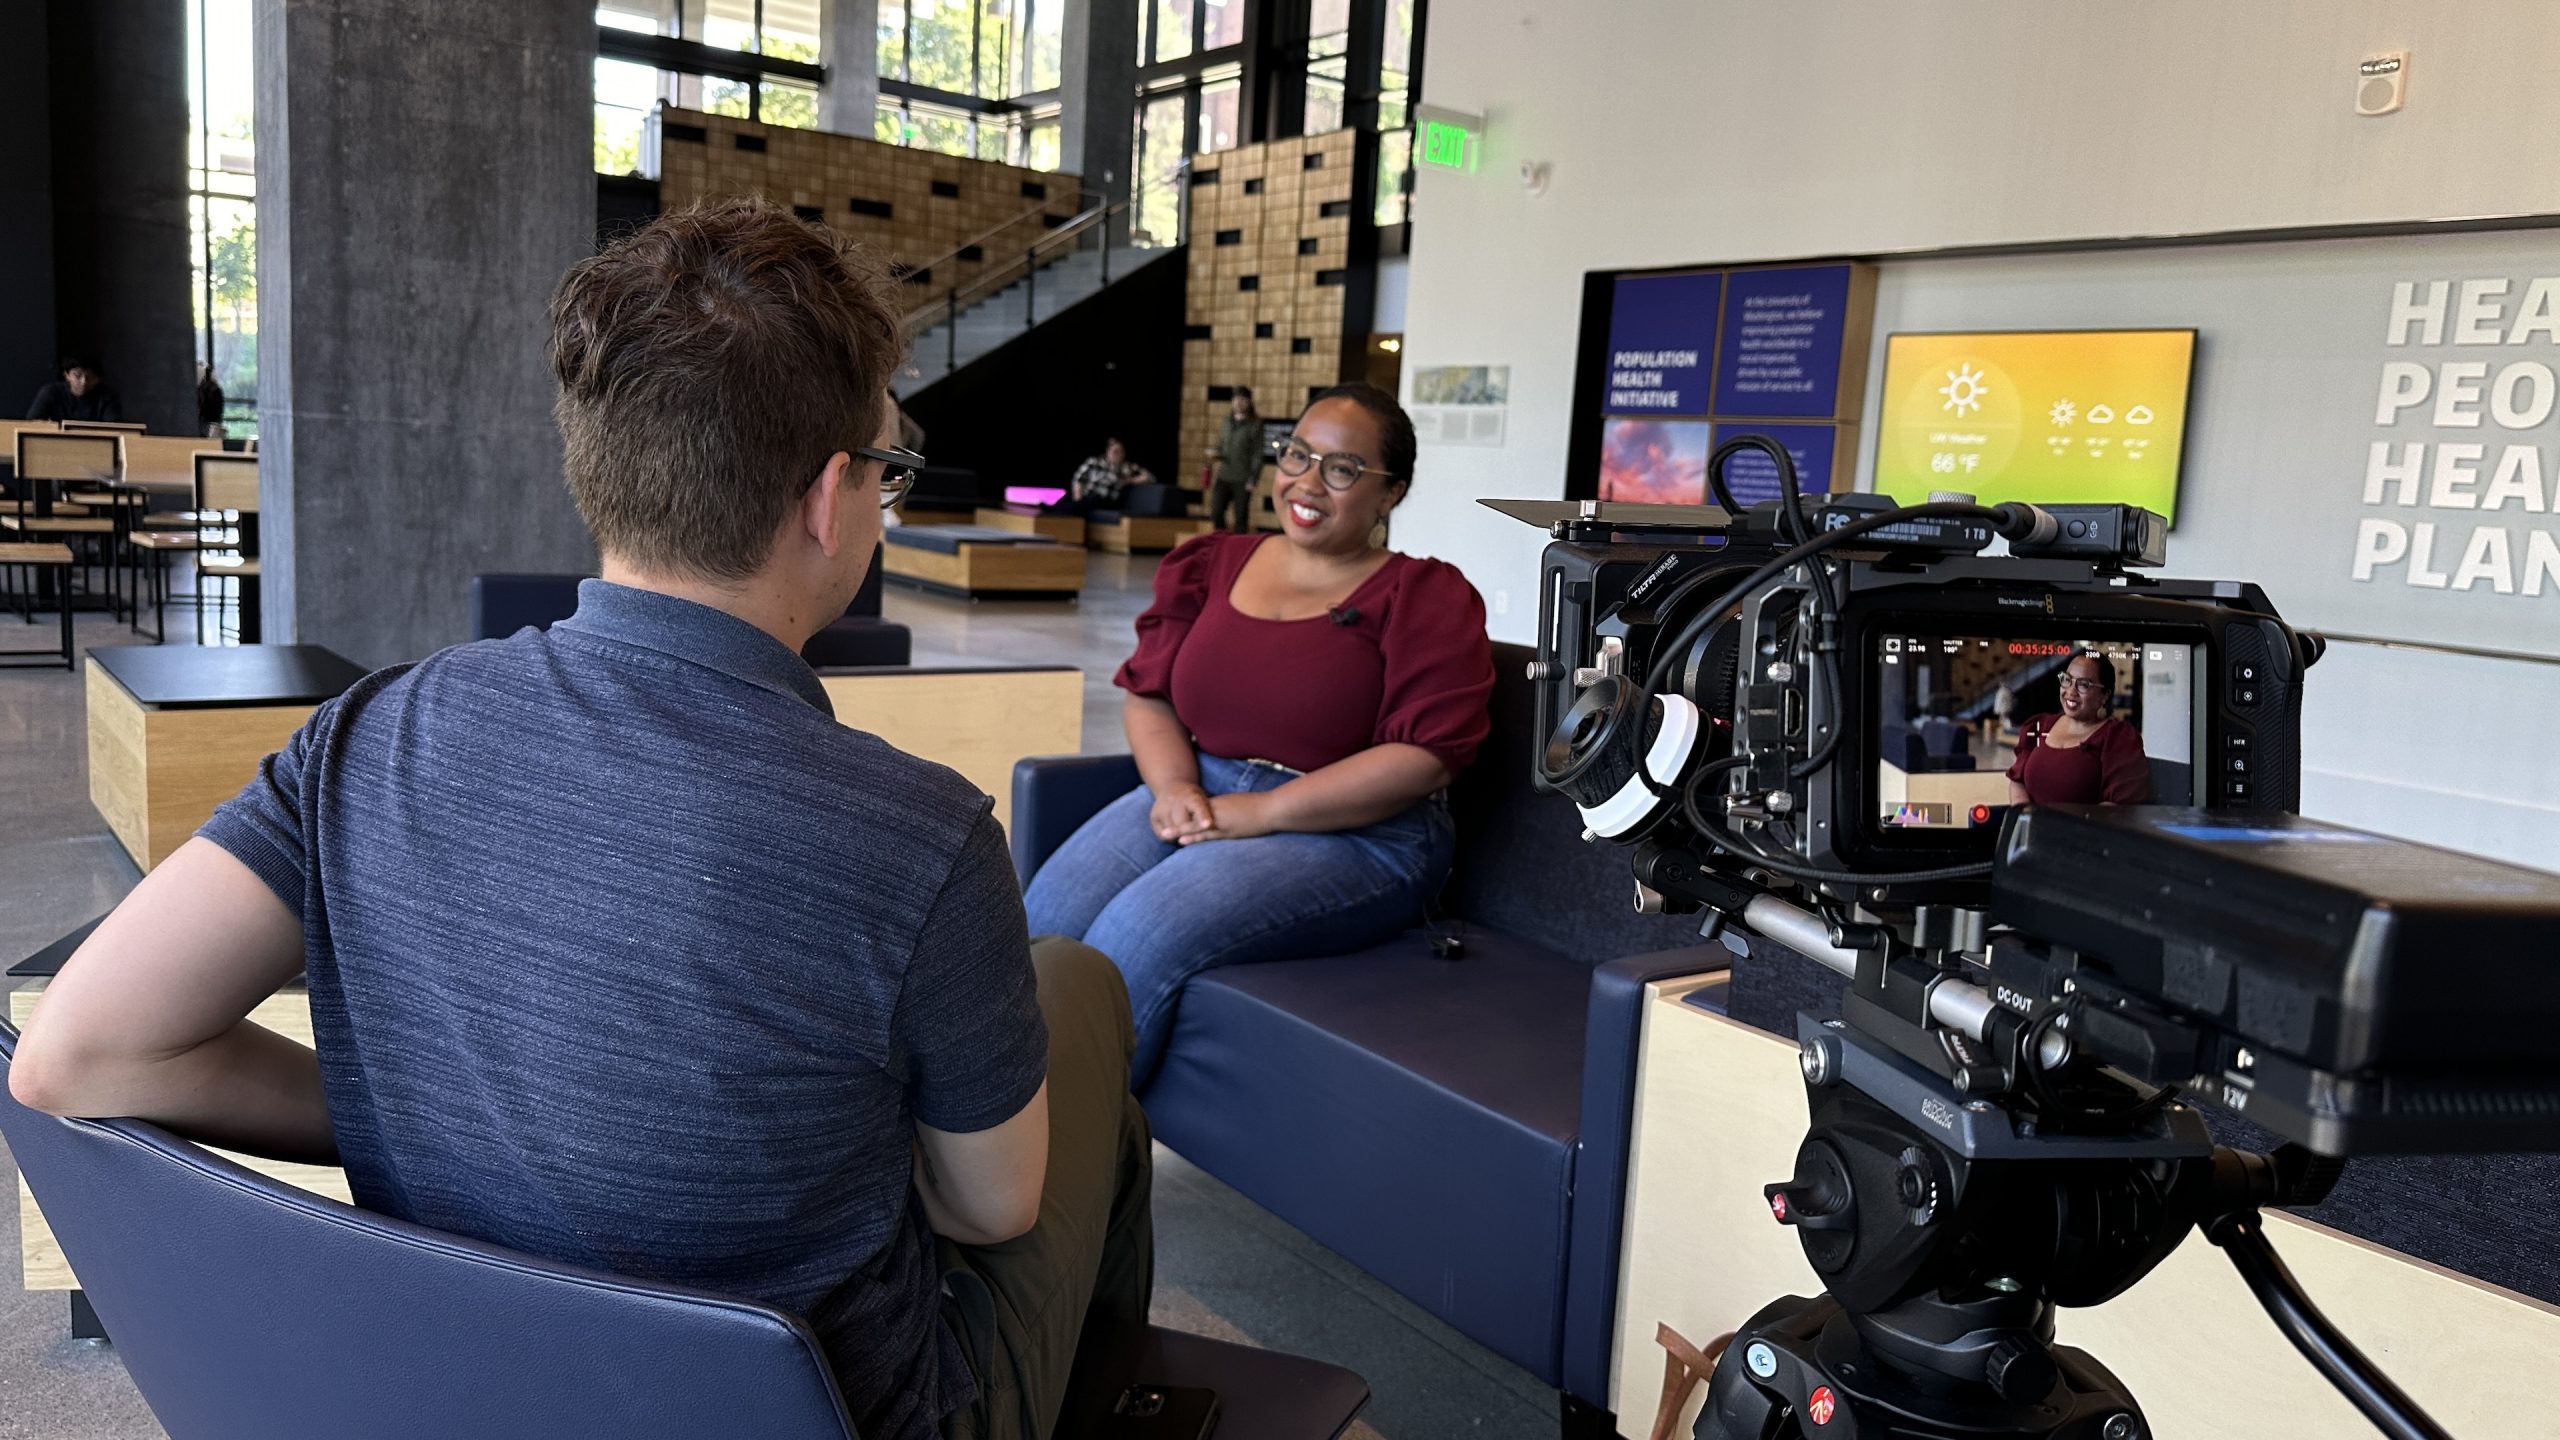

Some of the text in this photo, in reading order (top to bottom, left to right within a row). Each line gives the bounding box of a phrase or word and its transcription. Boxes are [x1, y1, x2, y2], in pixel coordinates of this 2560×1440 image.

[1426, 120, 1467, 168] EXIT
[1613, 350, 1698, 369] POPULATION
[1612, 370, 1663, 388] HEALTH
[1610, 390, 1679, 408] INITIATIVE
[1931, 452, 1956, 474] 66
[2362, 442, 2560, 515] HEA
[1963, 527, 1986, 542] 1 TB
[1631, 573, 1656, 599] TILTA
[1908, 645, 1926, 653] 23.98
[2008, 643, 2070, 656] 00:35:25:00
[2085, 651, 2100, 660] 3200
[1997, 986, 2032, 1013] DC OUT
[2223, 1085, 2248, 1111] 12V
